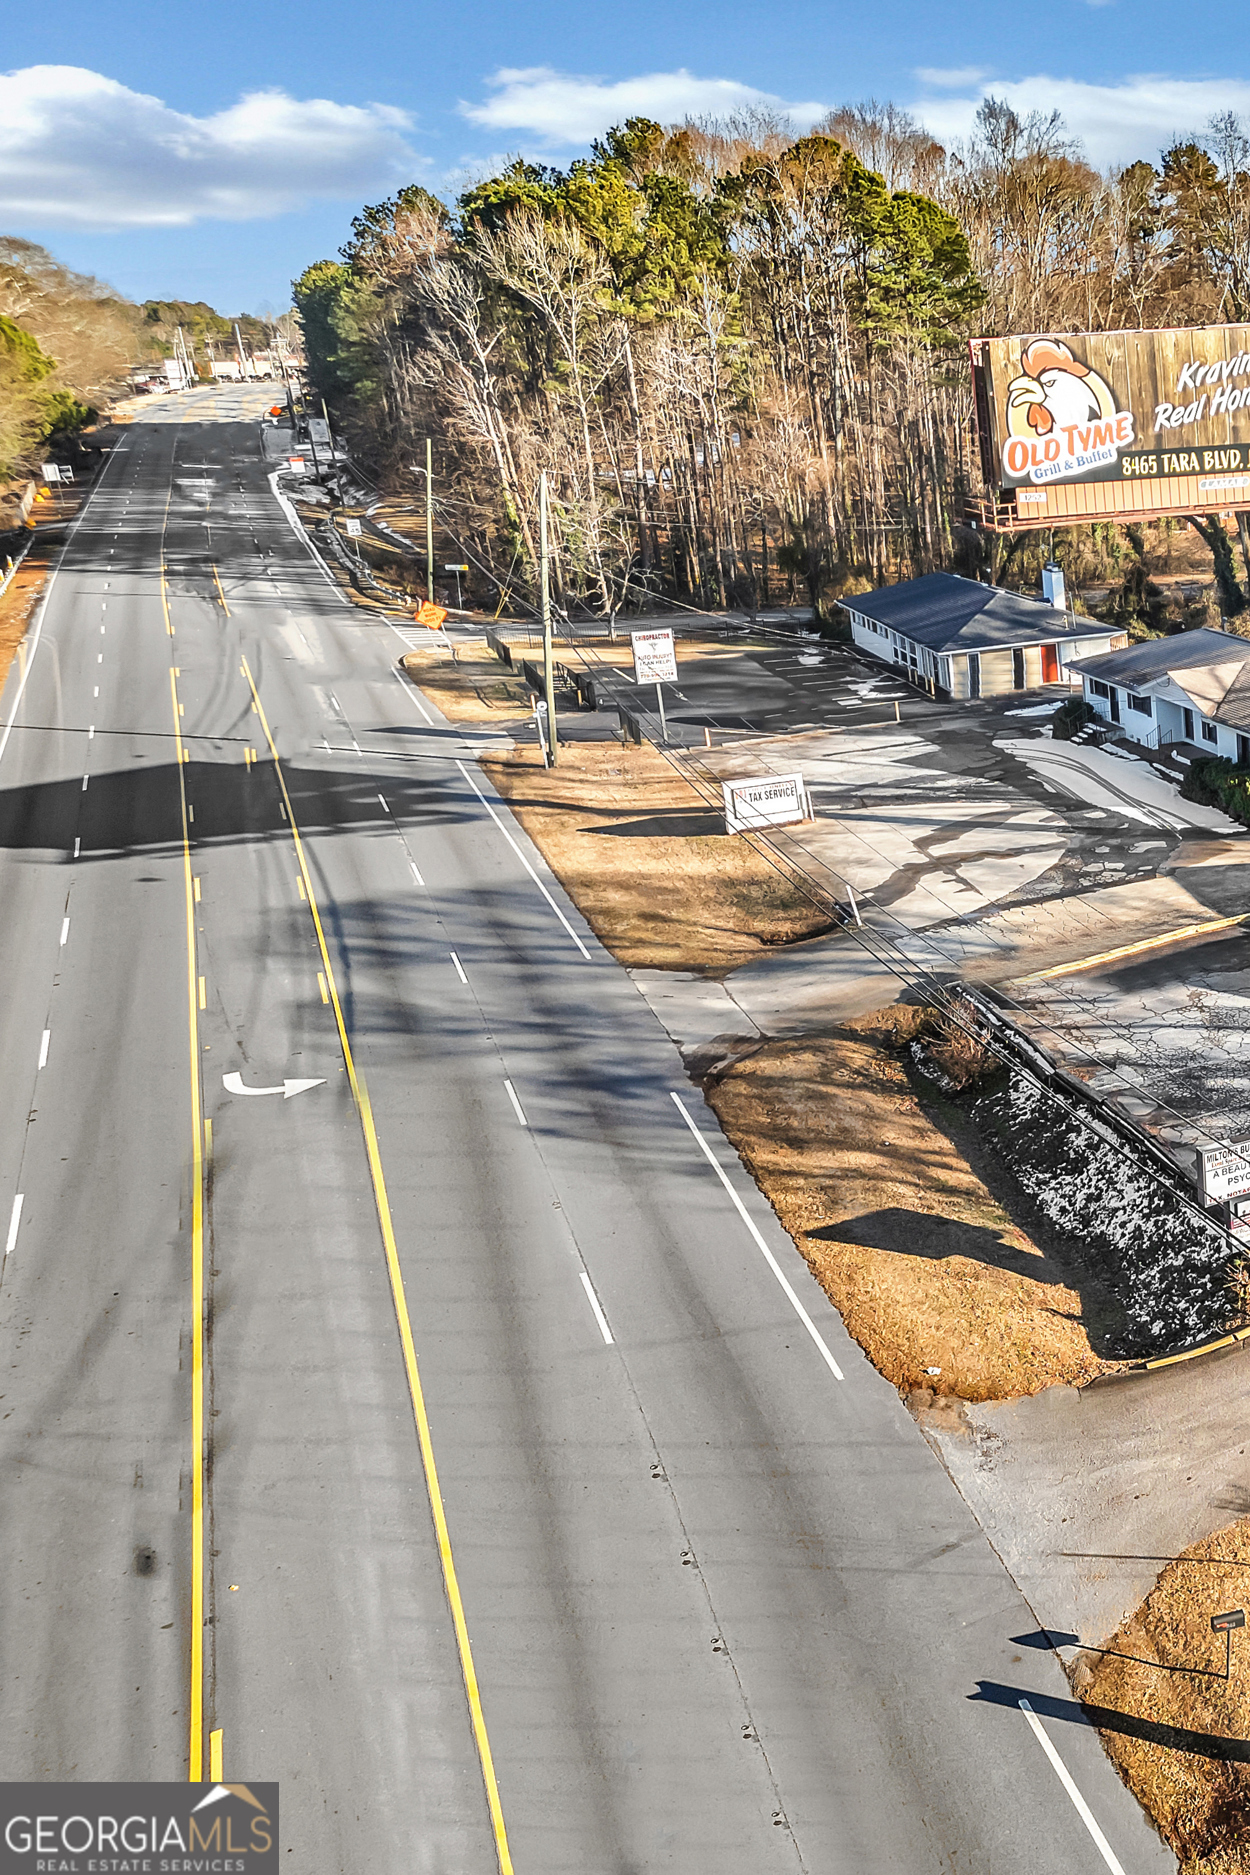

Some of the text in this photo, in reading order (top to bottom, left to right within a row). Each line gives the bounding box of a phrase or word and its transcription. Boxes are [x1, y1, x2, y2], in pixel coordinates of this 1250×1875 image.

[1154, 393, 1208, 432] Real
[1008, 438, 1060, 472] OLD
[1034, 448, 1113, 479] Grill & Buffet
[1122, 455, 1157, 475] 8465
[1161, 452, 1200, 473] TARA
[1203, 449, 1243, 470] BLVD,
[635, 633, 670, 641] CHIROPRACTOR
[749, 791, 763, 802] TAX
[764, 786, 795, 800] SERVICE
[1212, 1170, 1220, 1179] A
